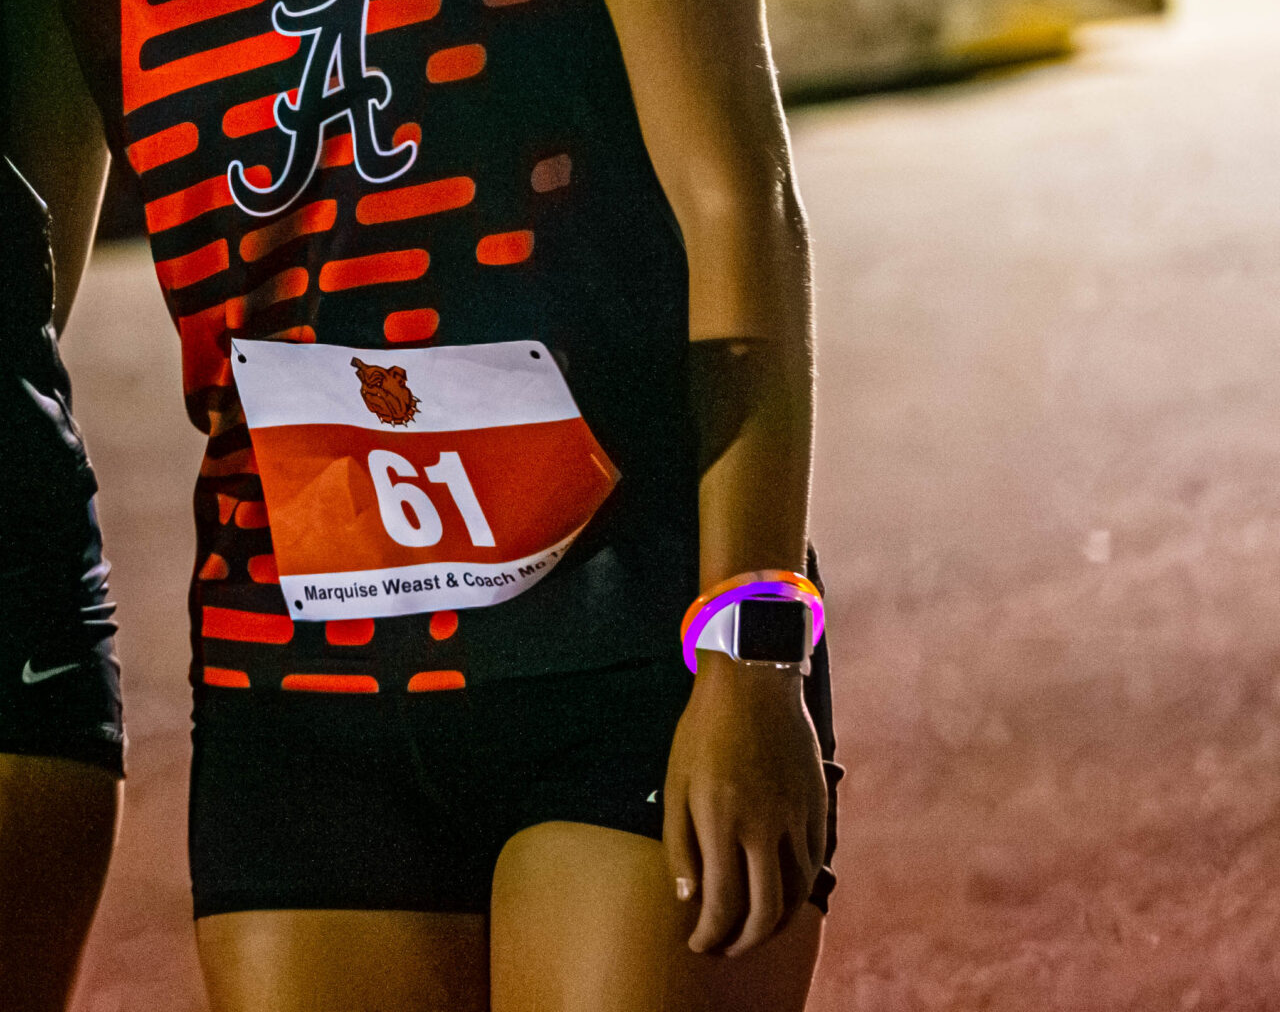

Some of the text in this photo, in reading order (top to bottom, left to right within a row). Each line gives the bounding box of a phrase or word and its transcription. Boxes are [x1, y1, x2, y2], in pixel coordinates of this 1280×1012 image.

[367, 448, 496, 547] 61
[303, 581, 378, 603] Marquise
[382, 574, 441, 595] Weast
[445, 572, 459, 588] &
[463, 572, 516, 587] Coach
